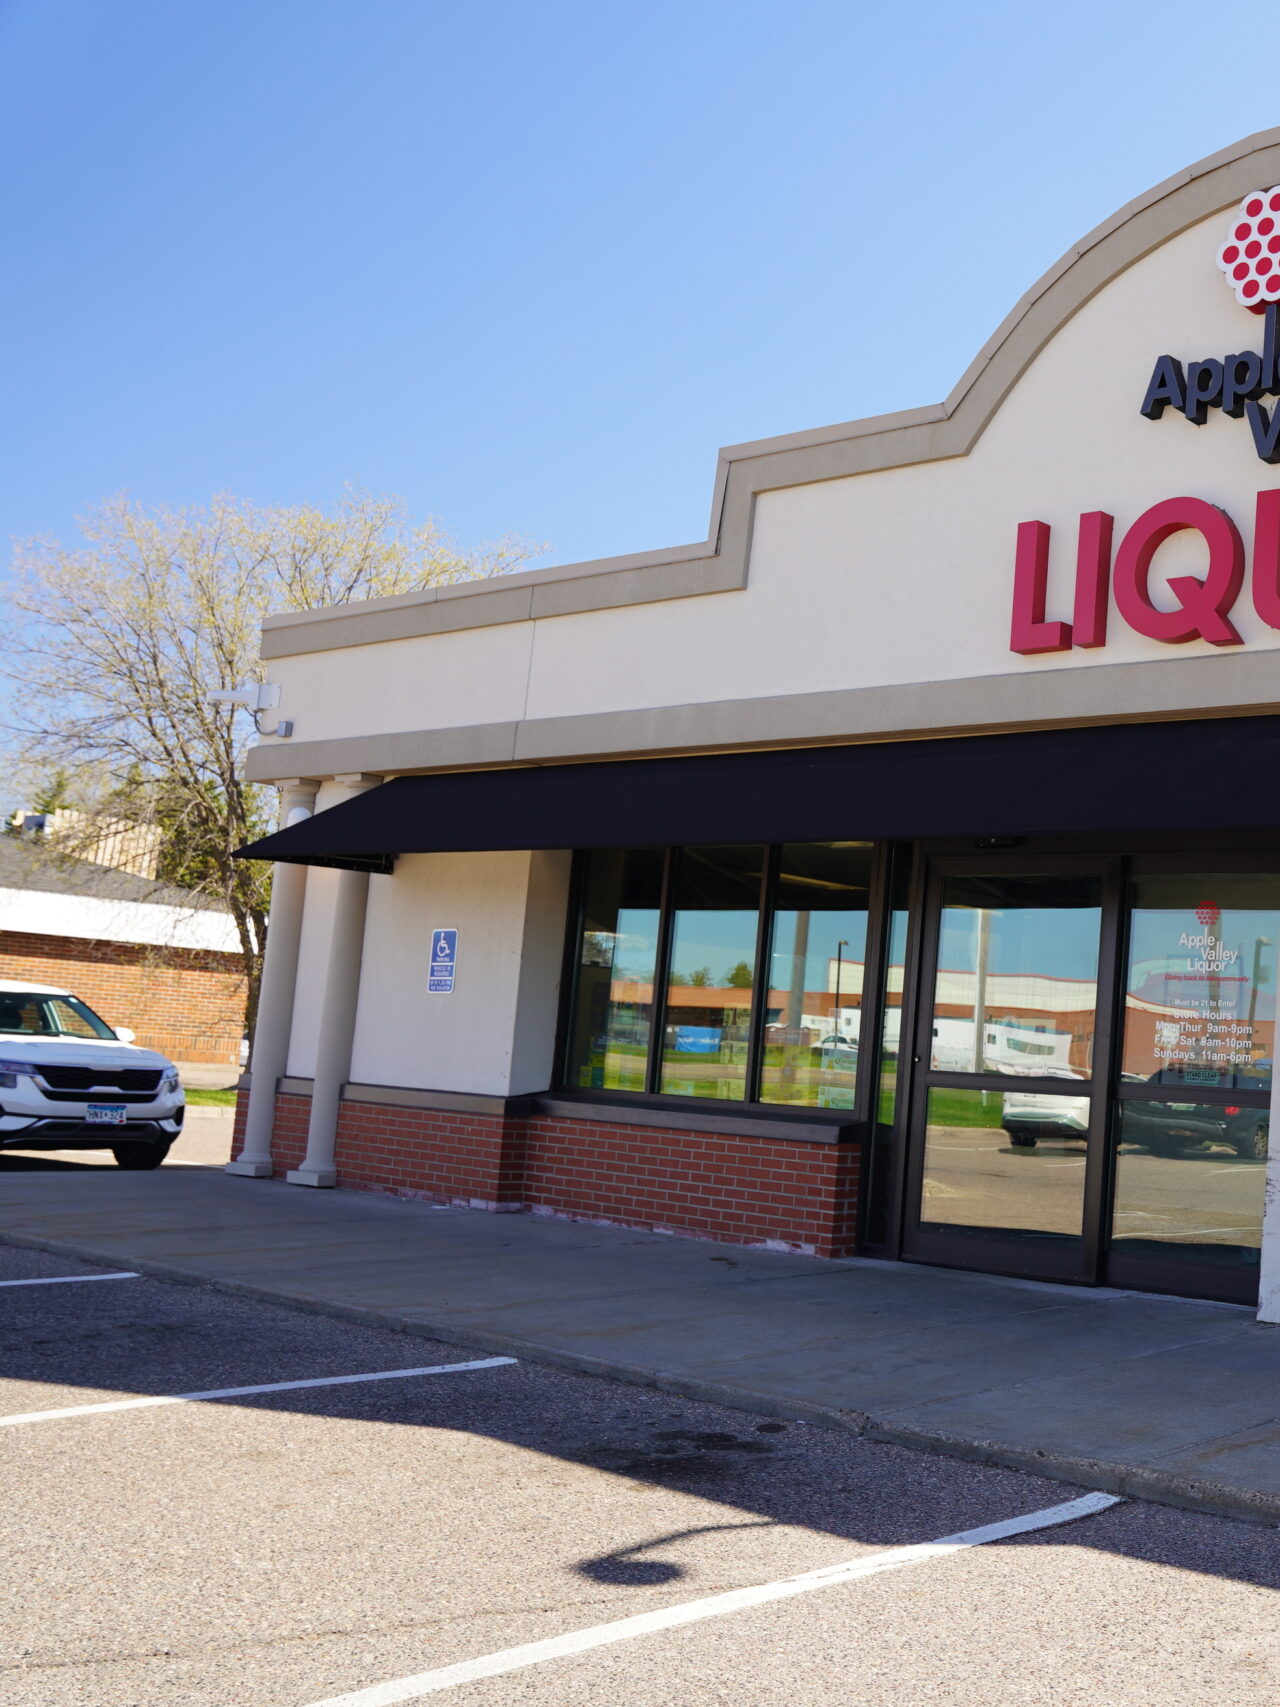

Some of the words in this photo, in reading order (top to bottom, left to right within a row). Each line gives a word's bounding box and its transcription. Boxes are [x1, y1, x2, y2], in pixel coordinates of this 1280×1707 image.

[1178, 926, 1216, 949] Apple
[1201, 940, 1238, 965] Valley
[1187, 957, 1228, 974] Liquor
[1174, 998, 1190, 1006] Must
[1207, 1023, 1253, 1035] 9am-9pm
[1180, 1036, 1196, 1046] Sat
[1154, 1047, 1196, 1061] Sundays
[1202, 1050, 1251, 1063] 11am-6pm
